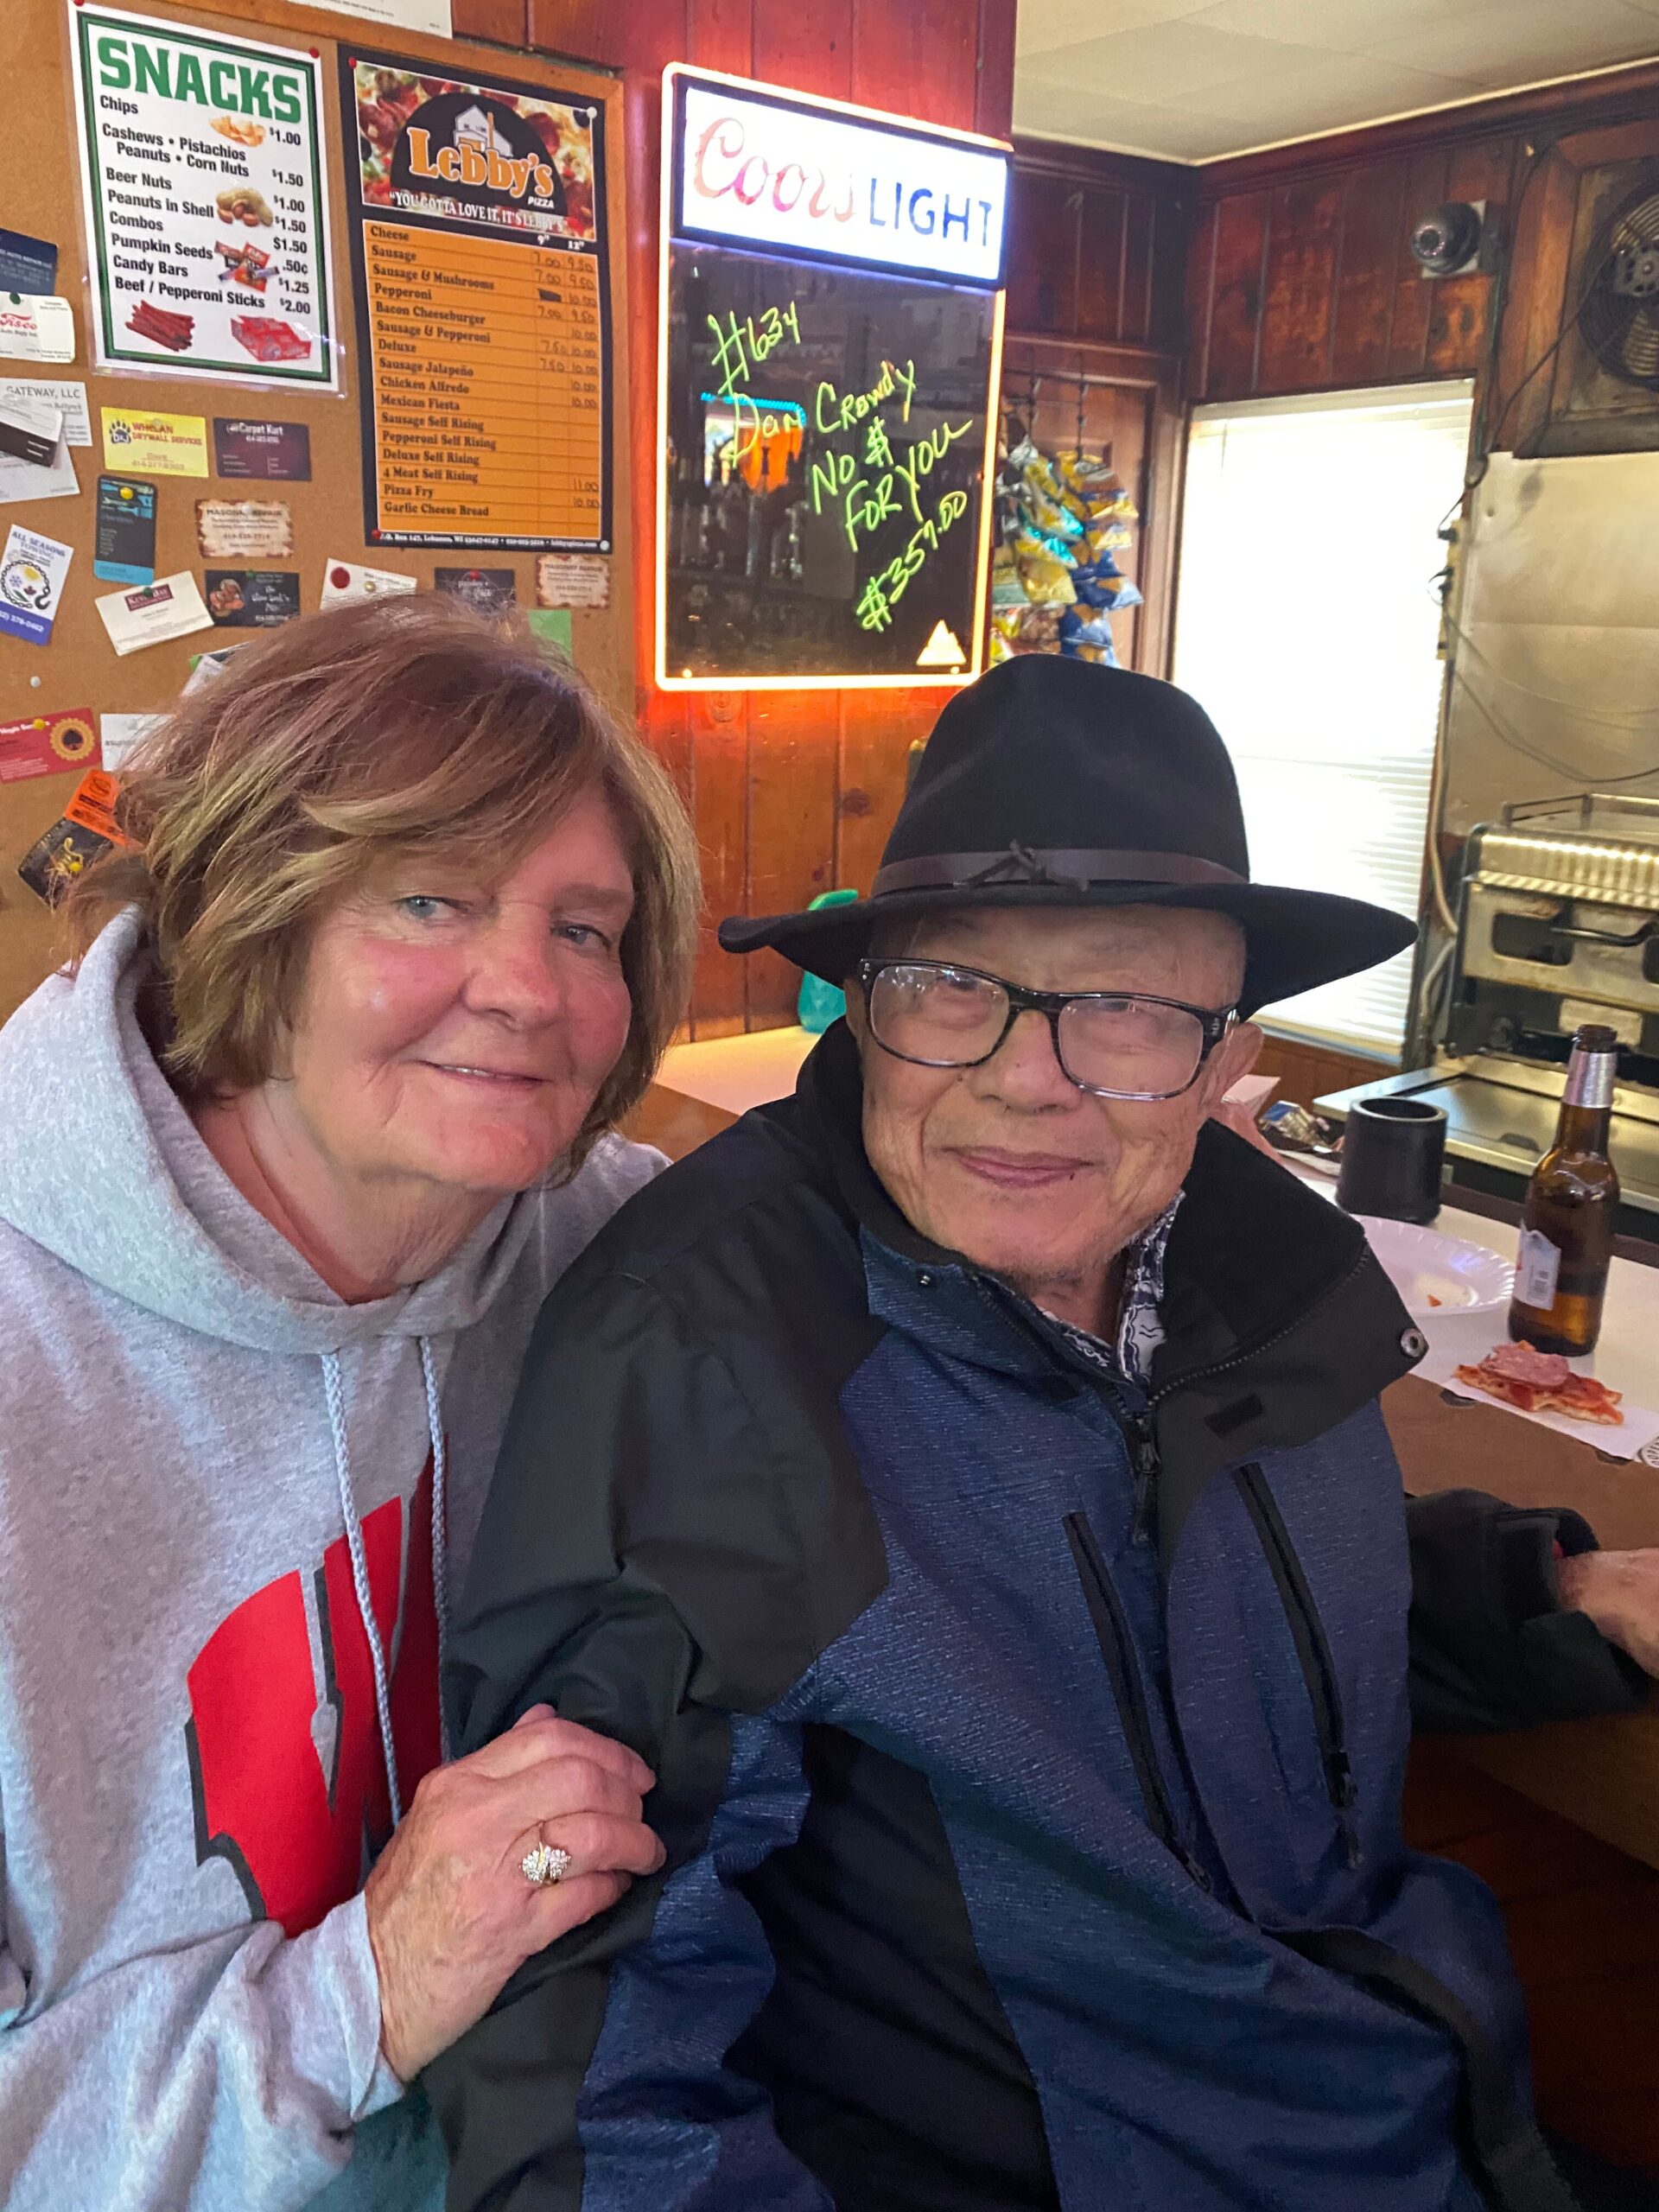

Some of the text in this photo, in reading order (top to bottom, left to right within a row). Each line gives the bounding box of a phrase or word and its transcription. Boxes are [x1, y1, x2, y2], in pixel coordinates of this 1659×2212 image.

[98, 36, 302, 124] SNACKS
[100, 94, 302, 146] Chips $1.00
[102, 123, 246, 161] Cashews Pistachios
[117, 142, 303, 187] Peanuts Corn Nuts $1.50
[407, 127, 554, 198] Lebby's
[105, 167, 305, 213] Beer Nuts $1.00
[108, 189, 306, 233] Peanuts in Shell $1.50
[421, 196, 457, 215] GOTTA
[459, 203, 486, 220] LOVE
[502, 209, 522, 226] IT'S
[528, 196, 554, 209] PIZZA
[869, 178, 994, 247] LIGHT
[110, 210, 307, 253] Combos $1.50
[371, 226, 409, 242] Cheese
[111, 232, 170, 255] Pumpkin
[175, 242, 213, 260] Seeds
[372, 245, 416, 262] Sausage
[113, 254, 309, 295] Candy Bars $1.25
[373, 264, 418, 281] Sausage
[421, 270, 431, 282] &
[434, 272, 495, 290] Mushrooms
[115, 276, 145, 293] Beef
[159, 283, 223, 303] Pepperoni
[226, 291, 265, 308] Sticks
[280, 298, 310, 315] $2.00
[374, 283, 432, 302] Pepperoni
[376, 302, 410, 317] Bacon
[414, 306, 486, 326] Cheeseburger
[378, 321, 422, 338] Sausage
[423, 326, 434, 337] &
[437, 327, 491, 344] Pepperoni
[378, 339, 416, 354] Deluxe
[379, 358, 423, 374] Sausage
[426, 361, 474, 378] Jalapeño
[61, 389, 80, 398] LLC
[380, 376, 426, 391] Chicken
[429, 381, 469, 395] Alfredo
[381, 393, 460, 411] Mexican Fiesta
[382, 412, 484, 433] Sausage Self Rising
[720, 392, 804, 469] Dan
[383, 431, 496, 451] Pepperoni Self Rising
[383, 449, 480, 467] Deluxe Self Rising
[384, 467, 391, 478] 4
[393, 467, 420, 479] Meat
[423, 469, 442, 480] Self
[446, 471, 478, 485] Rising
[384, 484, 412, 497] Pizza
[415, 486, 435, 500] Fry
[385, 502, 489, 517] Garlic Cheese Bread
[12, 531, 27, 543] ALL
[29, 537, 66, 557] SEASONS
